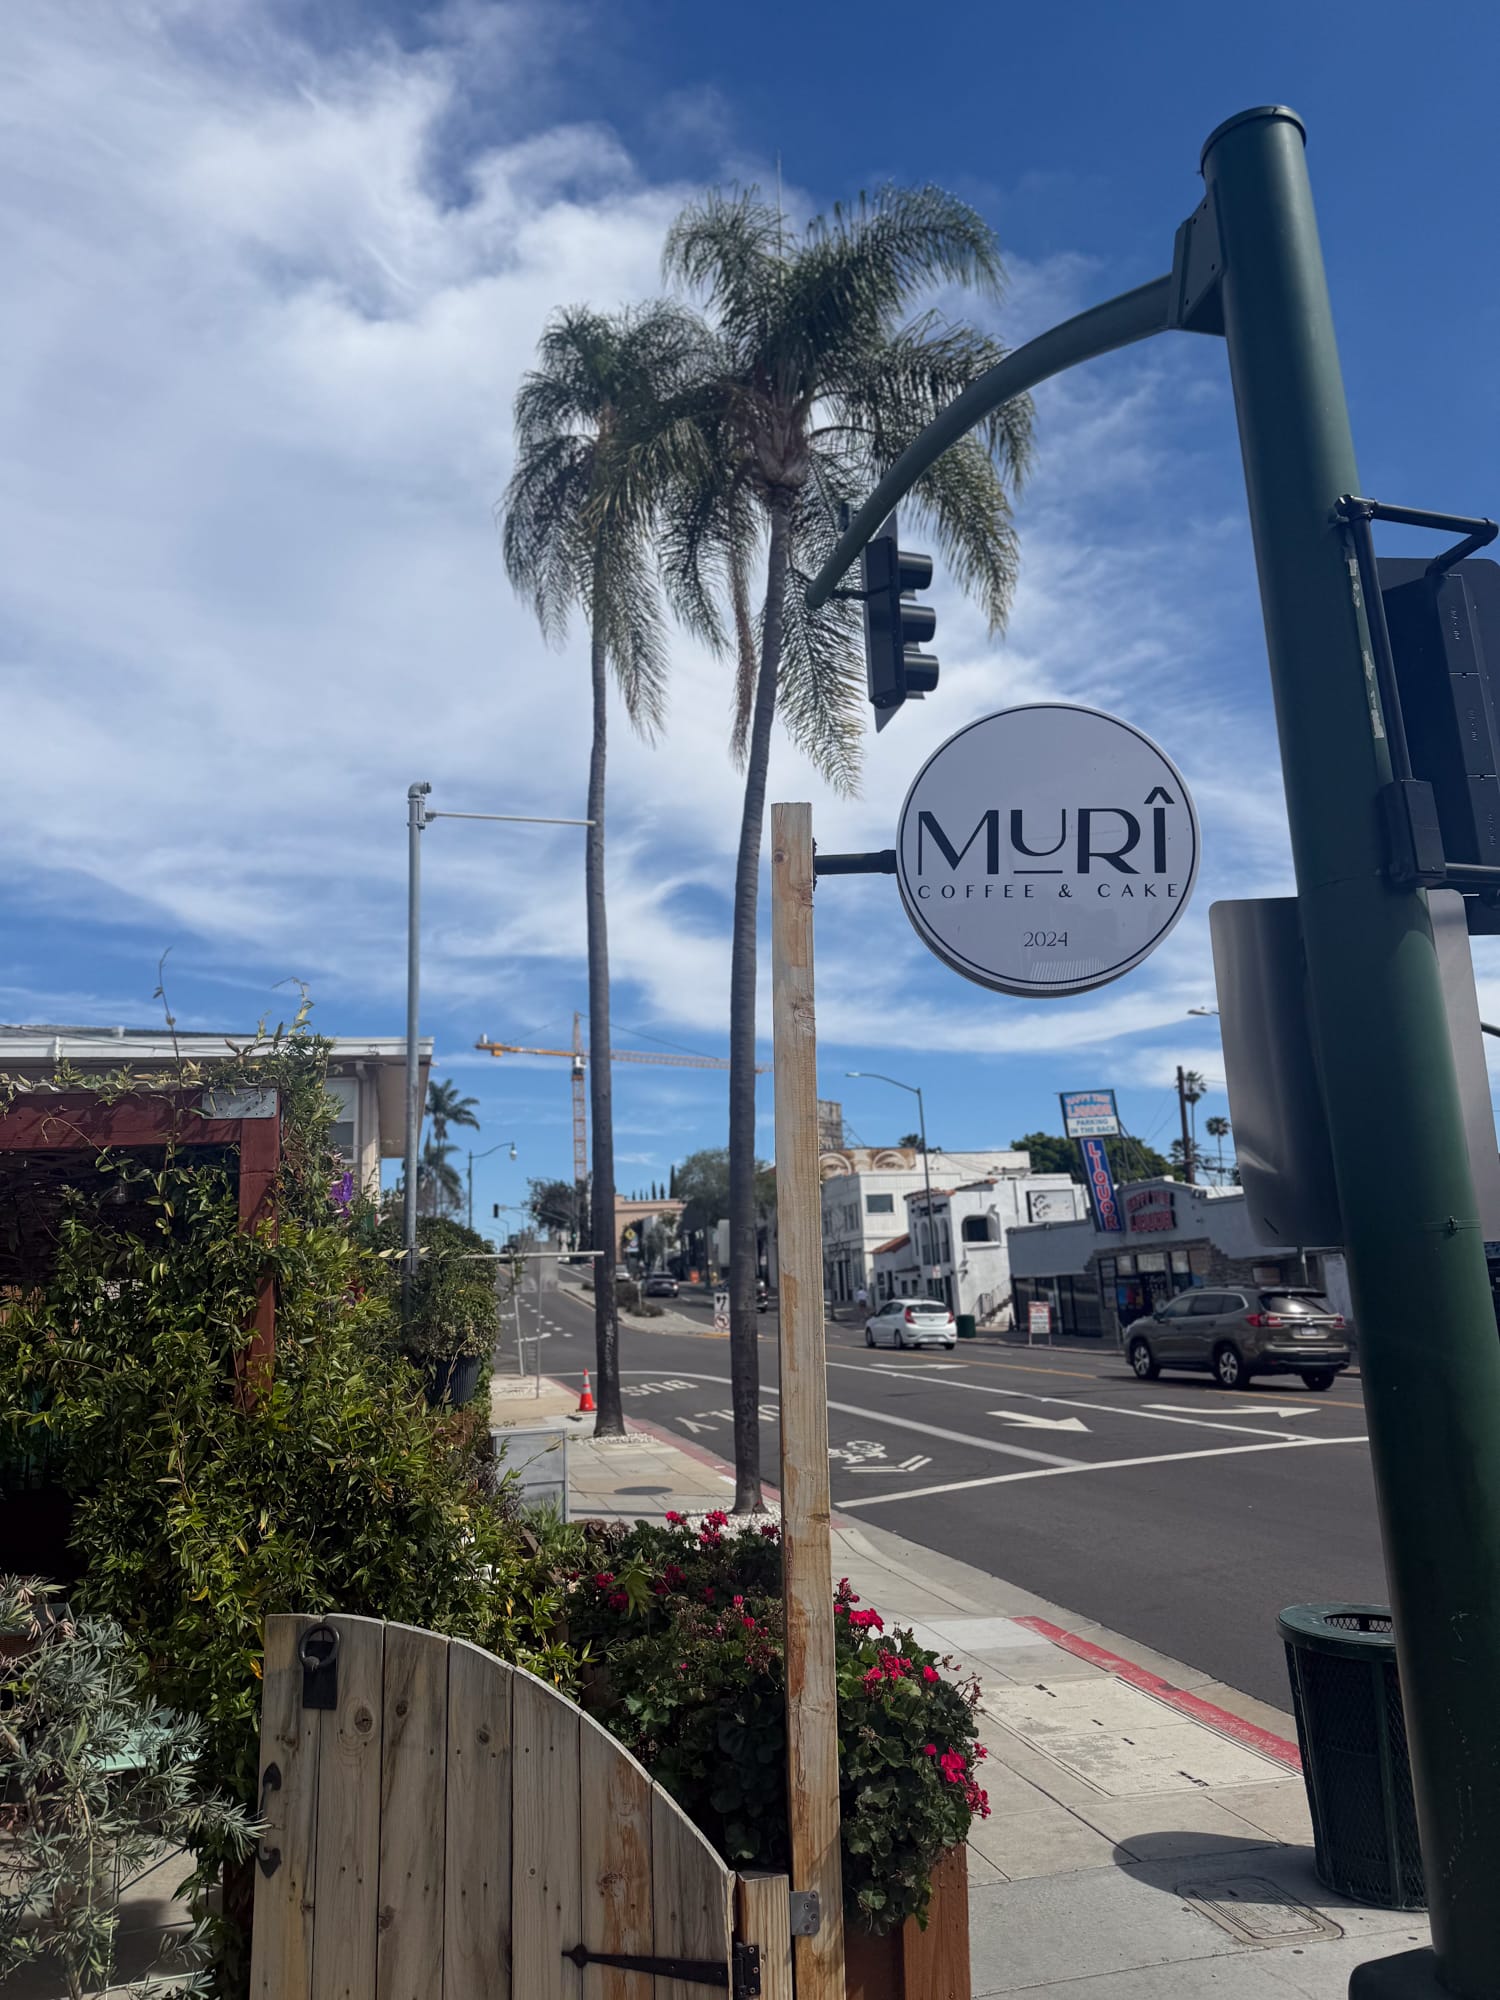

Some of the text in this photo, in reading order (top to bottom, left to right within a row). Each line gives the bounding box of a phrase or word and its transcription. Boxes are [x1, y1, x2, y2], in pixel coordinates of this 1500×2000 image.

[917, 786, 1175, 875] MURÎ
[917, 883, 1179, 899] COFFEE & CAKE
[1023, 931, 1069, 948] 2024
[1080, 1126, 1095, 1134] THE
[1096, 1125, 1117, 1133] BACK
[1087, 1142, 1119, 1230] LIQUOR
[620, 1380, 698, 1396] BUS
